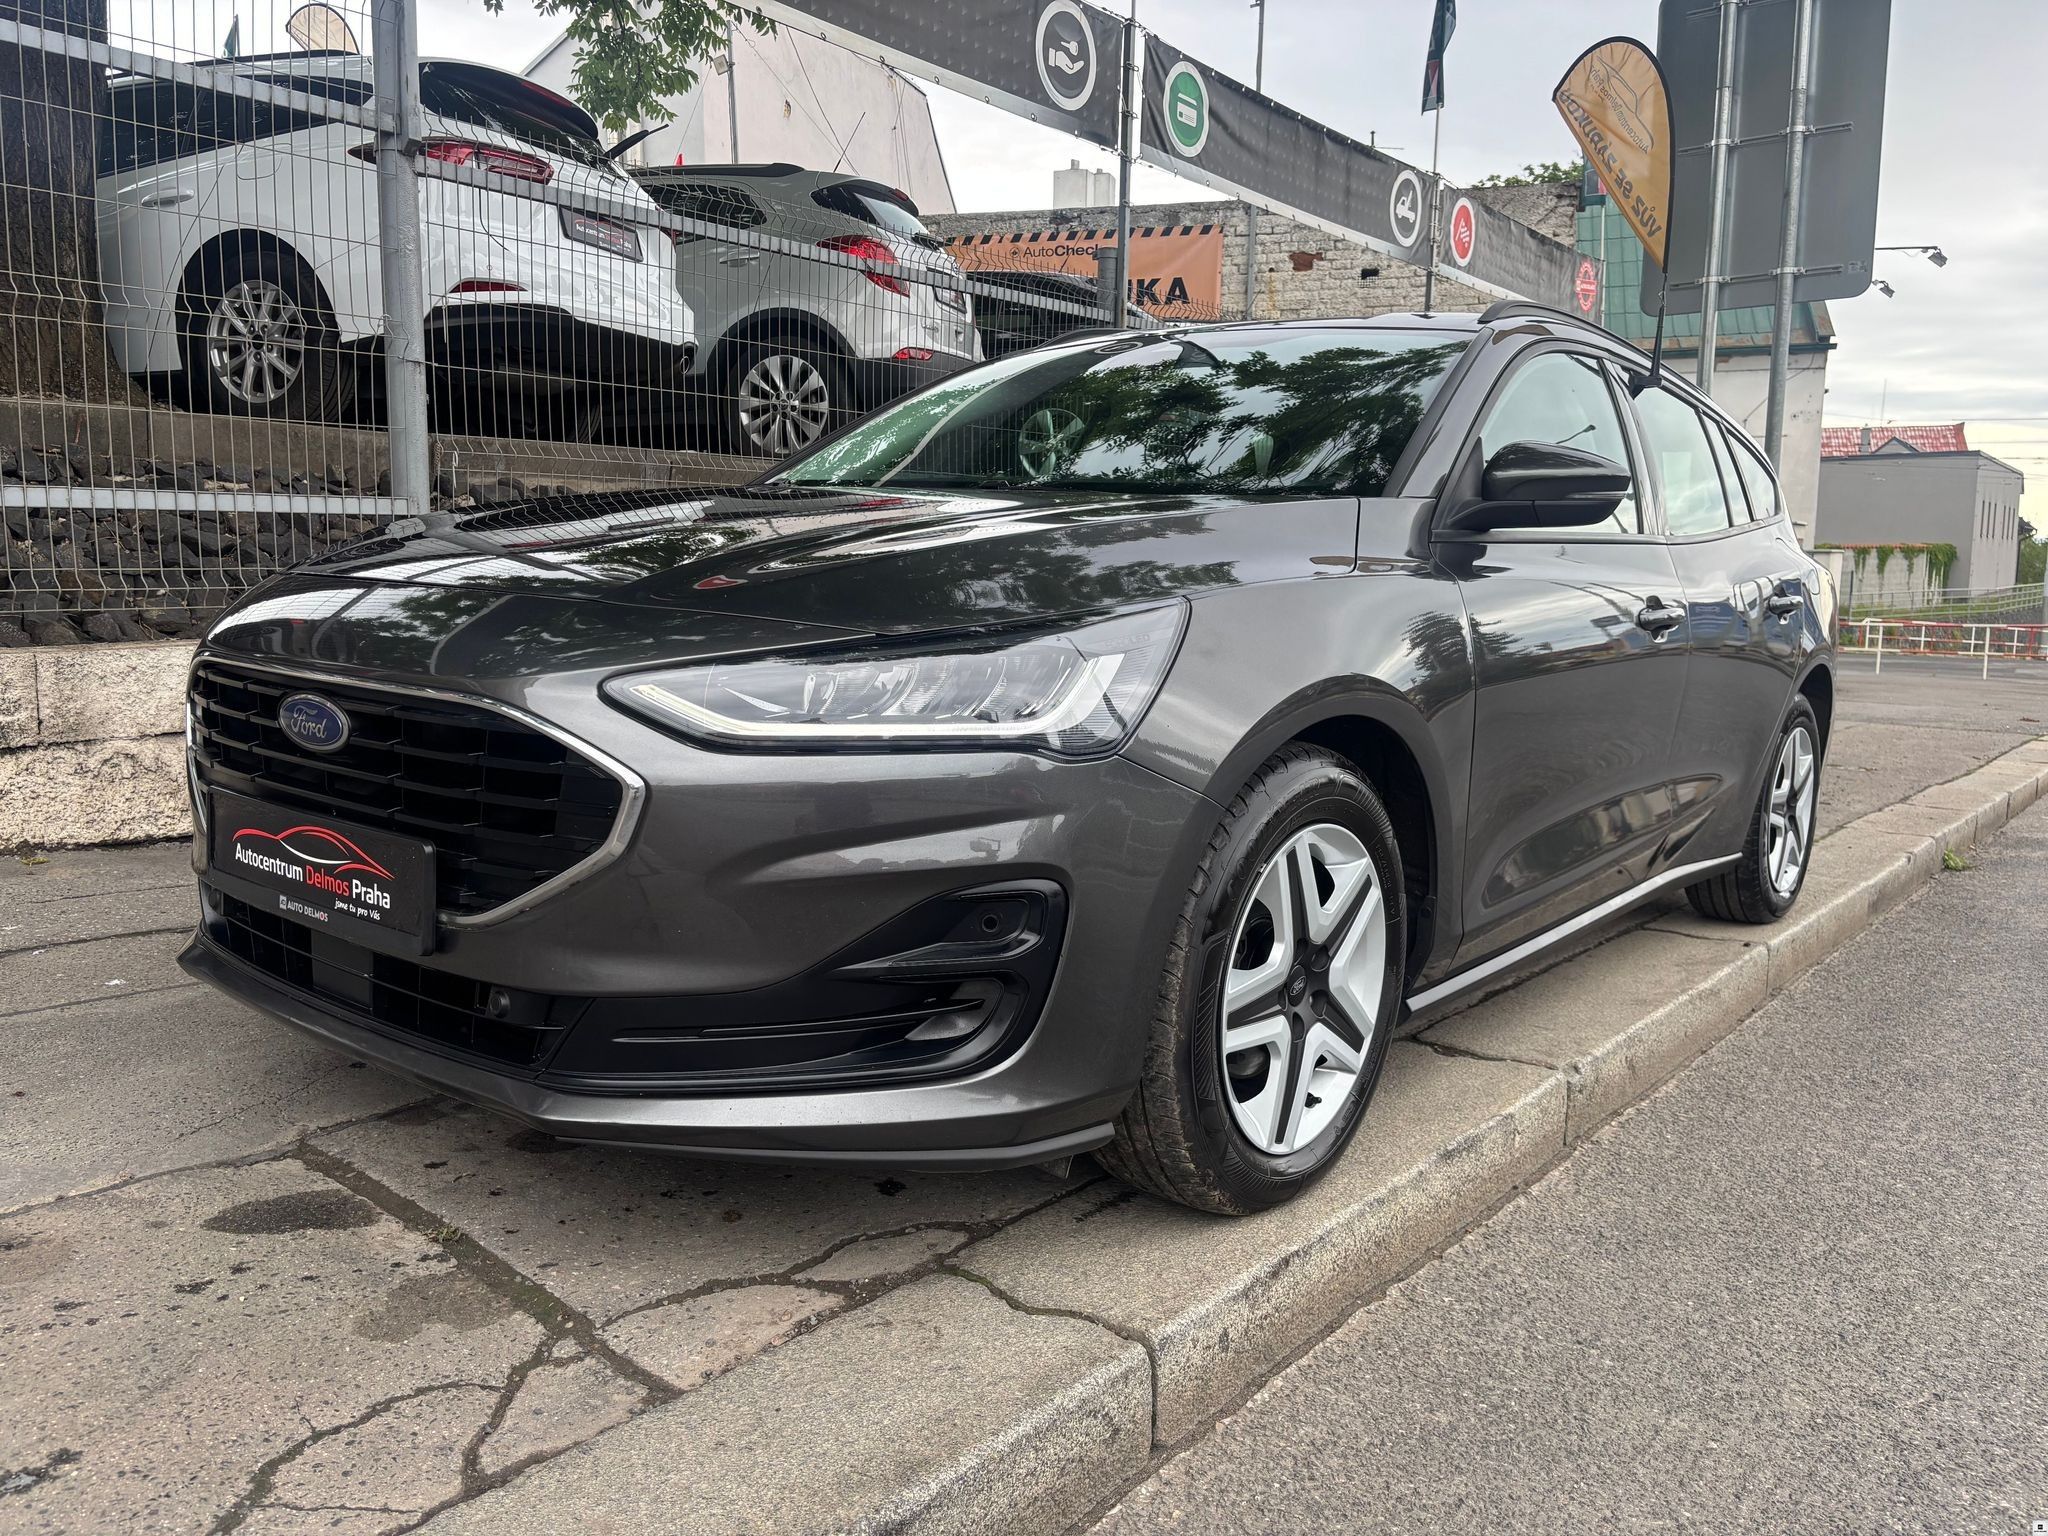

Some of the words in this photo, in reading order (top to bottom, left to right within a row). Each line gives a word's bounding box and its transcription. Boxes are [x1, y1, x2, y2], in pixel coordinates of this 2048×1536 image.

[1023, 243, 1099, 258] AutoChec
[291, 705, 328, 739] Ford
[235, 843, 303, 882] Autocentrum
[306, 864, 350, 897] Delmos
[352, 879, 391, 909] Praha
[287, 900, 303, 913] AUTO
[304, 906, 329, 922] DELMOS
[334, 897, 348, 910] jsme
[349, 904, 356, 913] tu
[357, 906, 368, 917] pro
[369, 909, 381, 920] Vás
